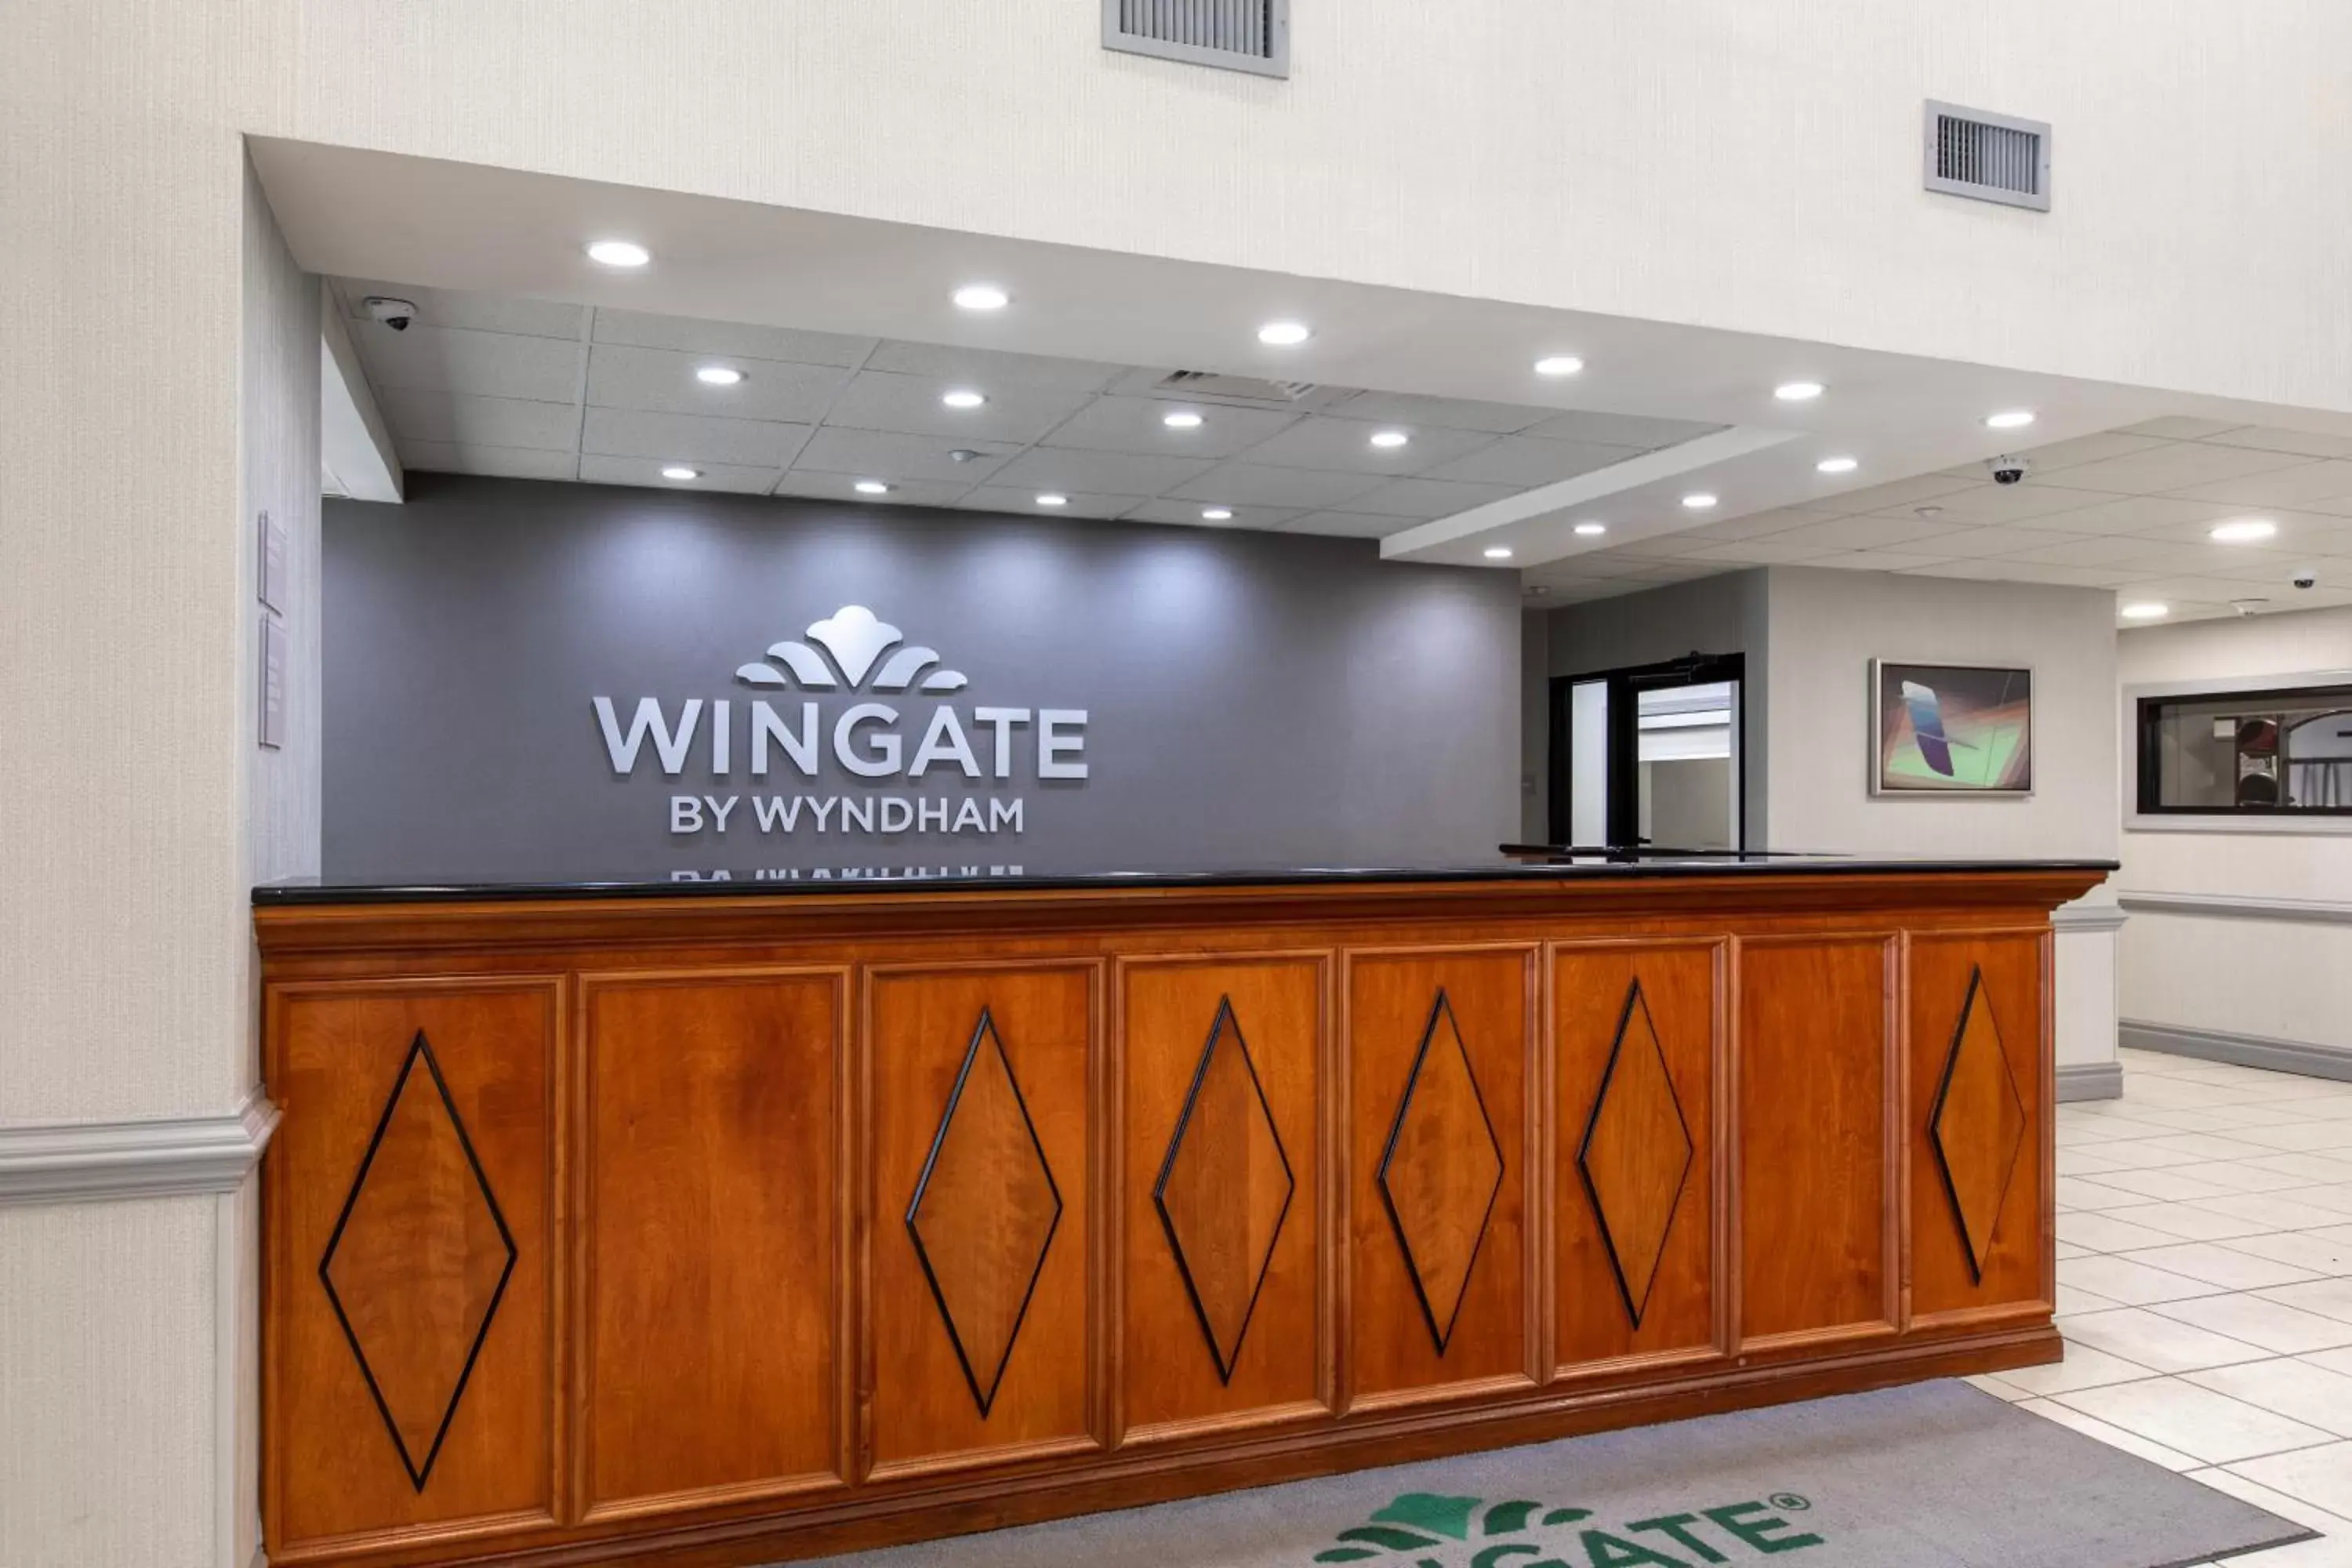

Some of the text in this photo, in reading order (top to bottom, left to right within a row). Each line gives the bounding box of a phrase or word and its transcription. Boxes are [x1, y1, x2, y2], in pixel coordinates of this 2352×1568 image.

[592, 696, 1088, 779] WINGATE
[670, 796, 1023, 833] BY WYNDHAM
